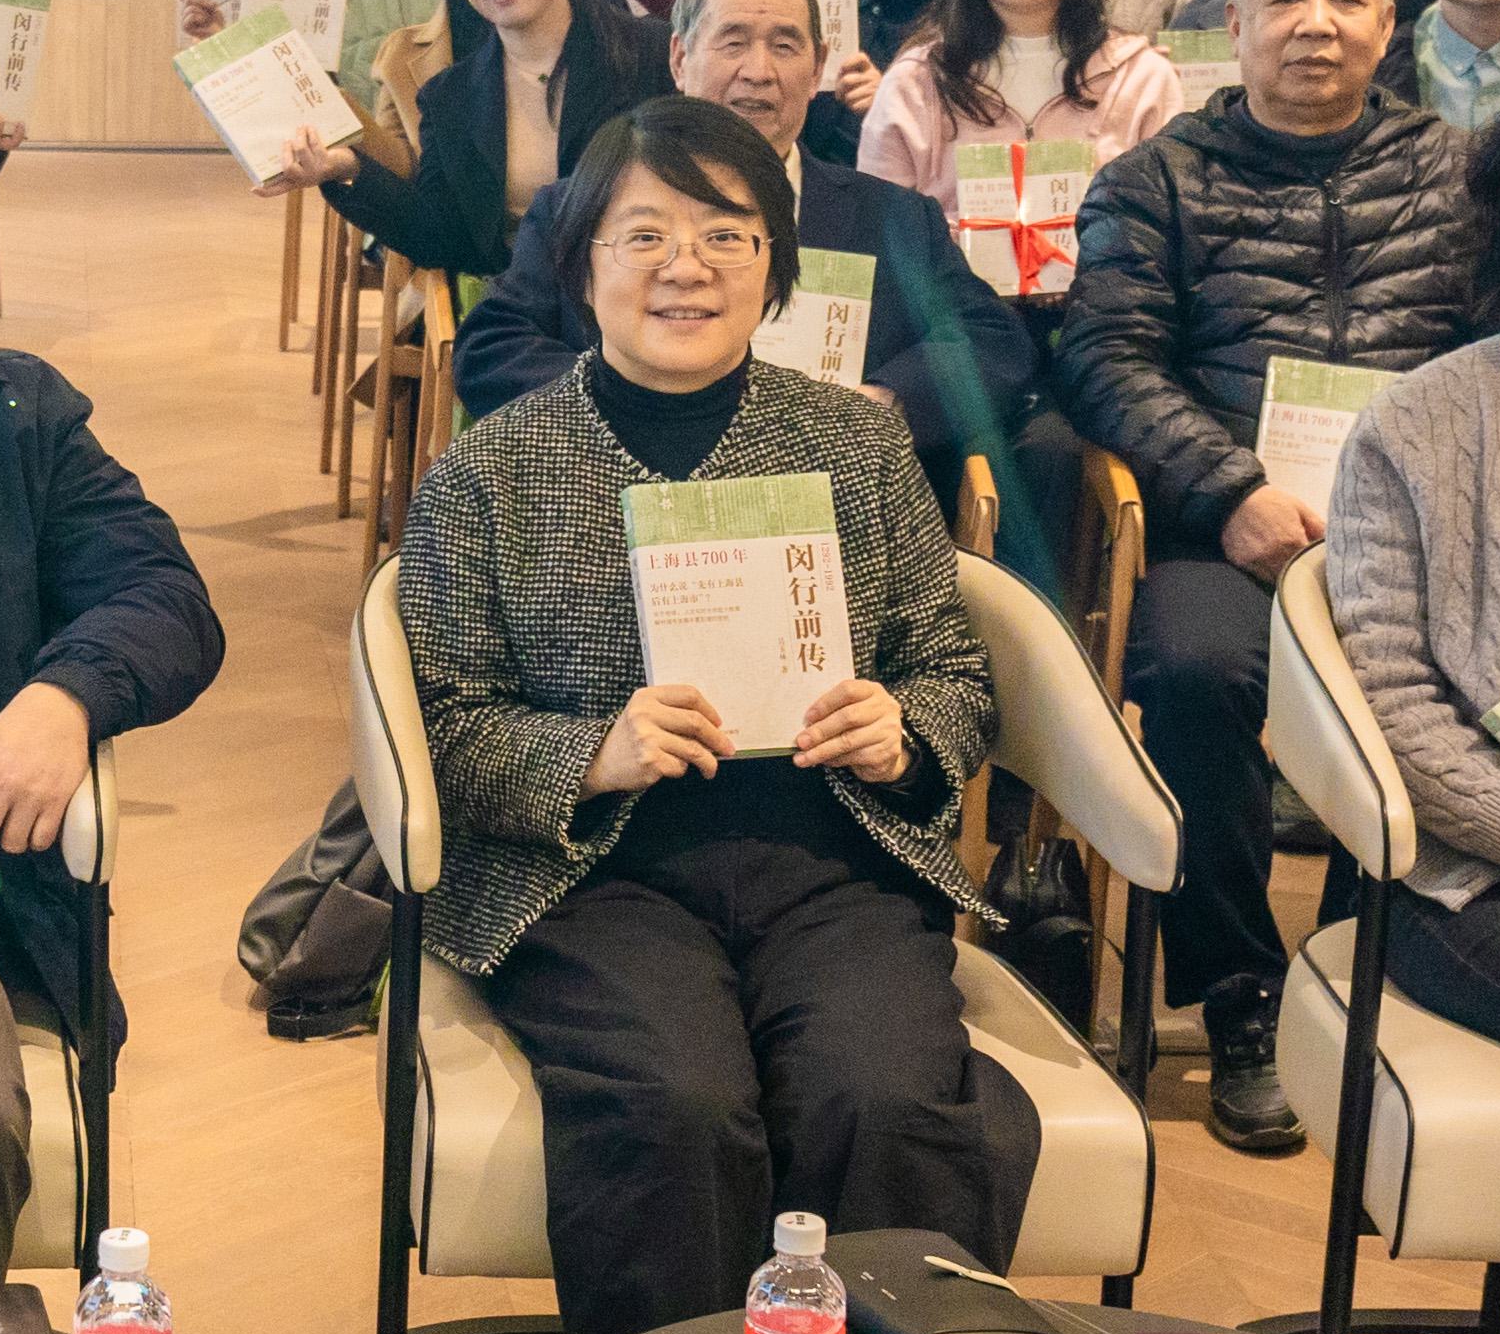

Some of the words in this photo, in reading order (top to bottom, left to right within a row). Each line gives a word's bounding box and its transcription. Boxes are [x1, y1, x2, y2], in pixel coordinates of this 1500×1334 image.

[5, 13, 31, 92] 闵行前传
[1051, 178, 1072, 250] 闵行传
[648, 548, 748, 570] 上海县700年
[785, 543, 827, 673] 闵行前传
